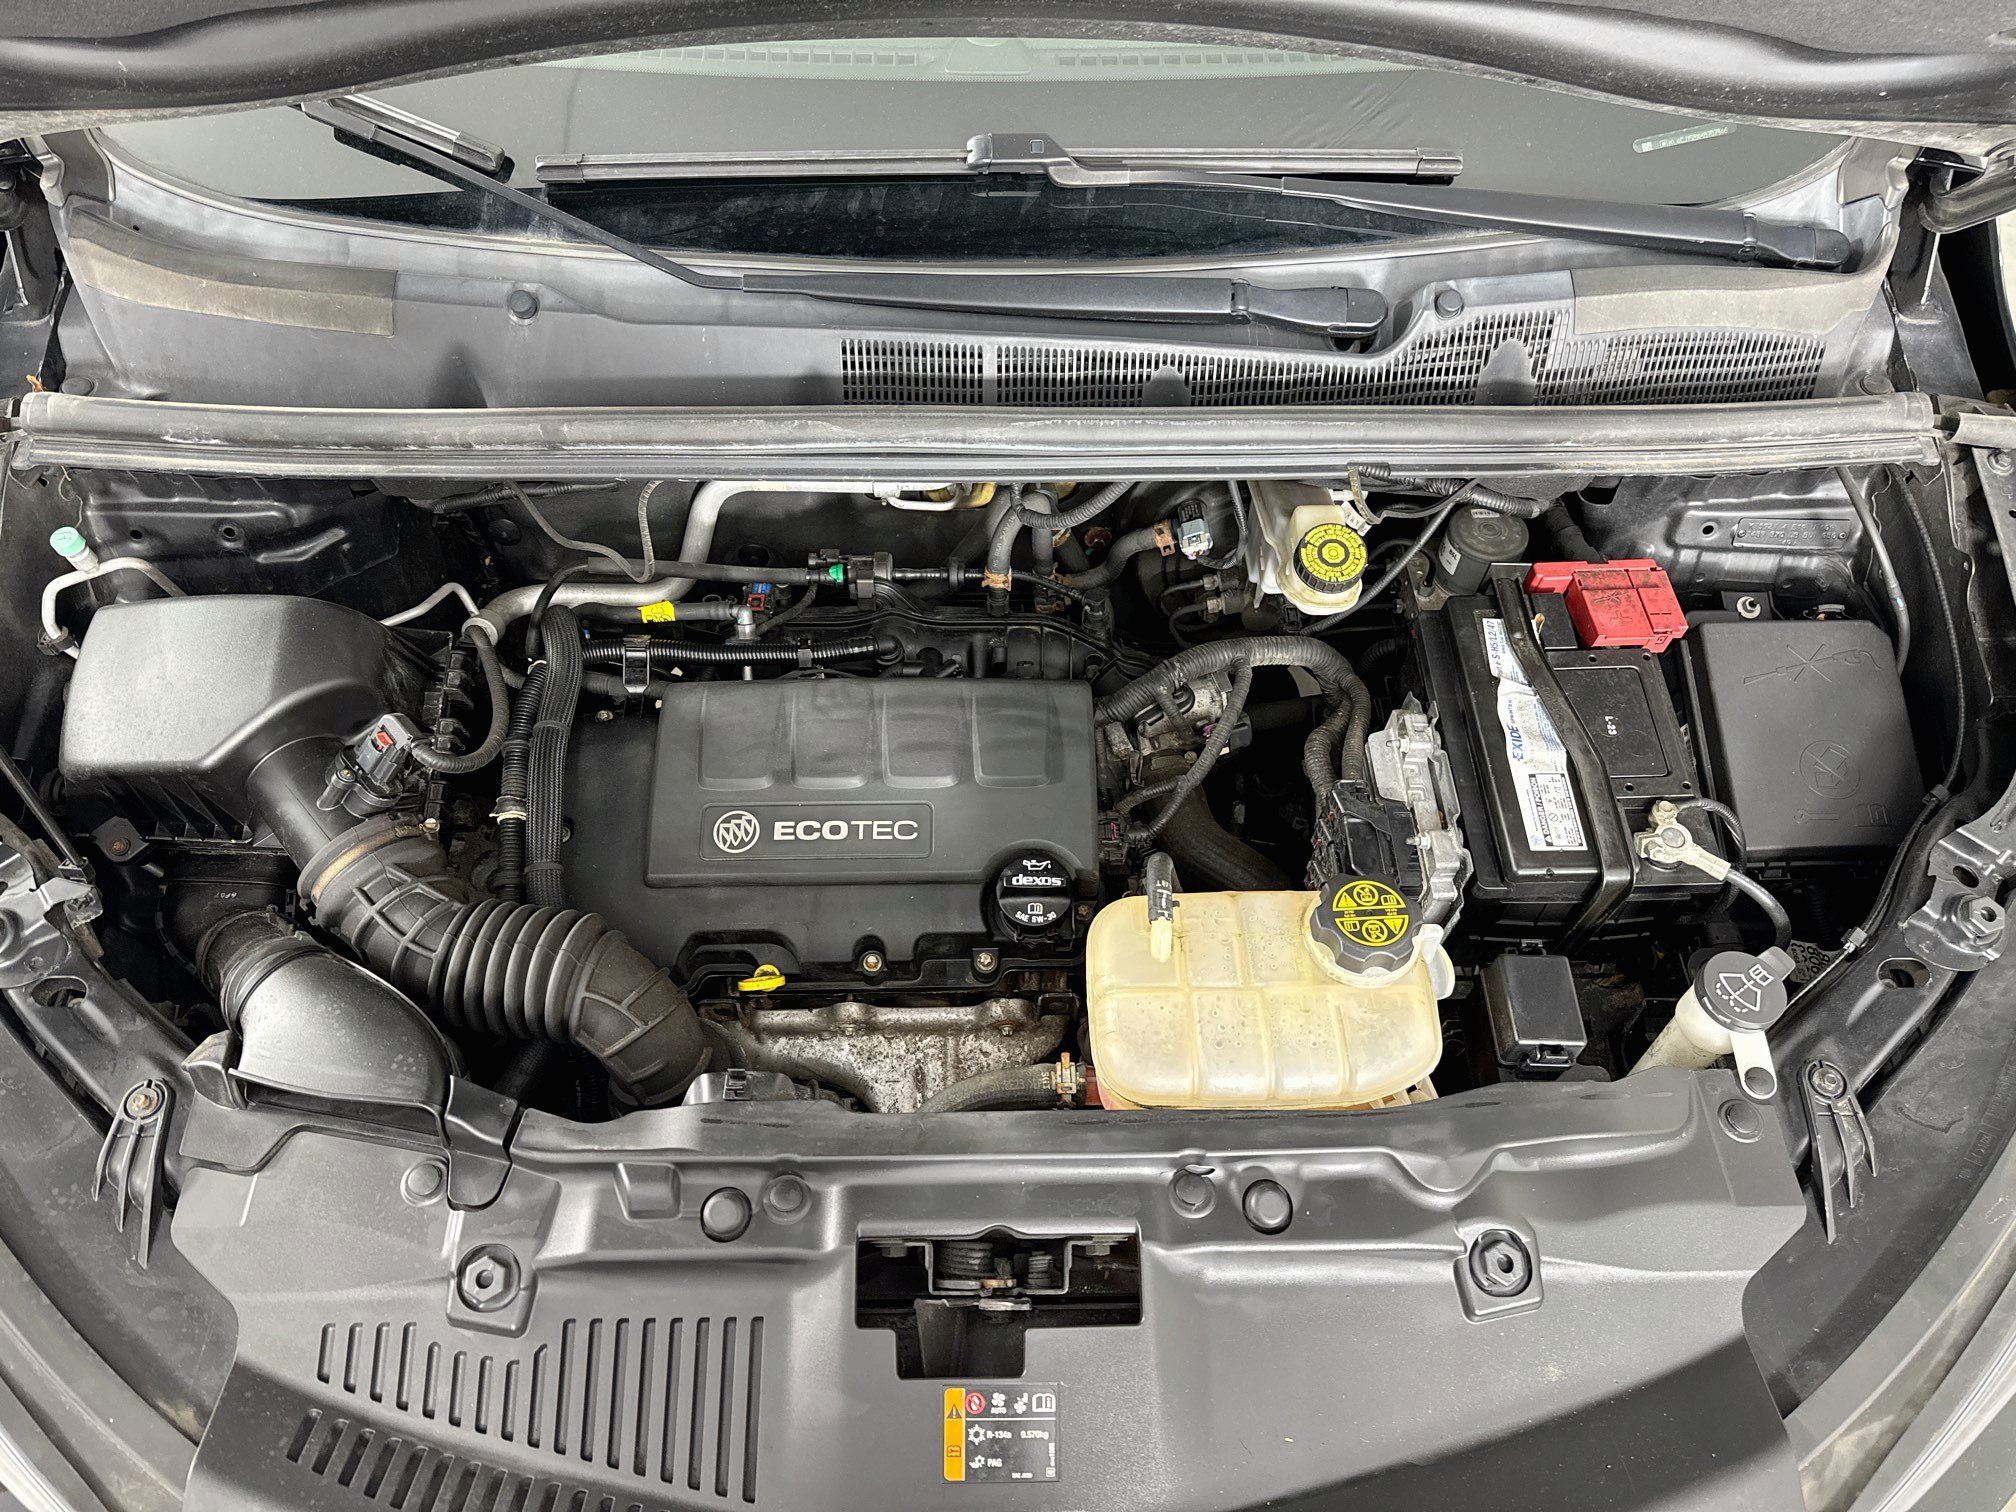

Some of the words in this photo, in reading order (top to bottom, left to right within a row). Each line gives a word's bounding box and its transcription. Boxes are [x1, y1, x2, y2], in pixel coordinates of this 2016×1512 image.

[1506, 723, 1523, 761] EXIDE
[773, 820, 918, 841] ECOTEC
[1012, 873, 1062, 886] dexos
[1015, 911, 1029, 922] SAE
[1031, 911, 1057, 923] 5W-30
[986, 1431, 1012, 1439] R-134a
[987, 1459, 1003, 1467] PAG
